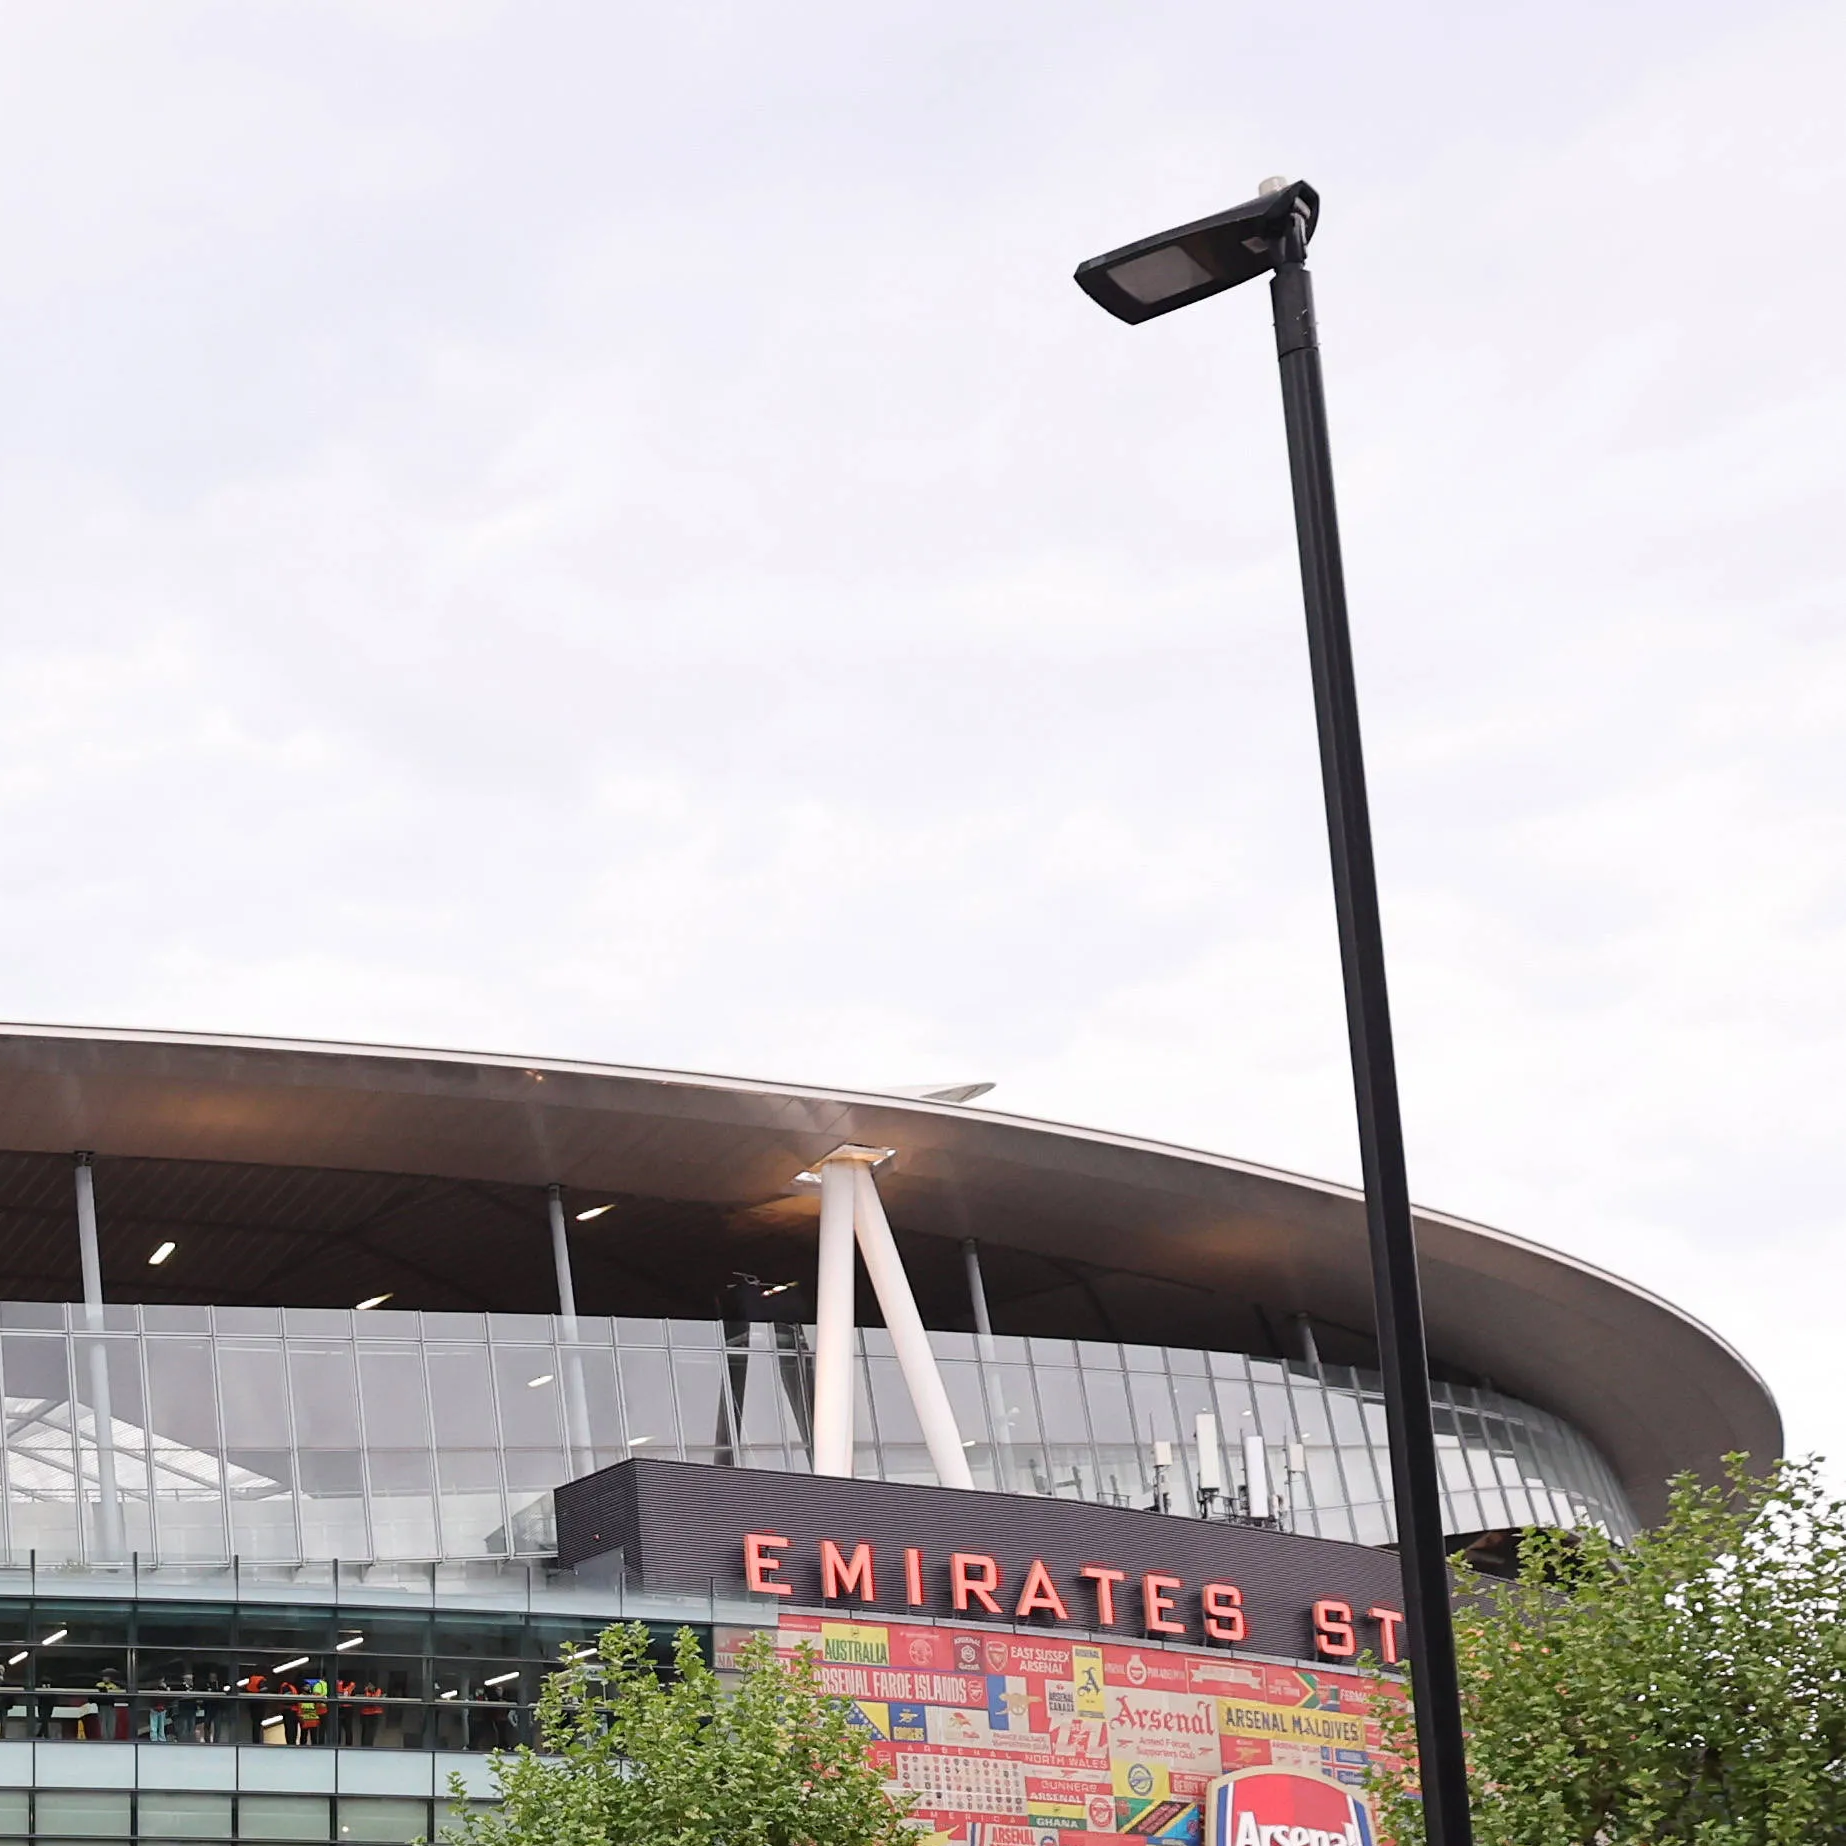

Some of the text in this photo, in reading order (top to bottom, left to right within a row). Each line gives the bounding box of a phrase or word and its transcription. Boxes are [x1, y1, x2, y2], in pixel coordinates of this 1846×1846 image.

[743, 1532, 1248, 1641] EMIRATES
[825, 1638, 888, 1665] AUSTRALIA
[1010, 1646, 1069, 1663] EAST SUSSEX
[1019, 1659, 1064, 1675] ARSENAL
[813, 1666, 967, 1703] ARSENAL FAROE ISLANDS
[1109, 1693, 1216, 1736] Arsenal
[1225, 1706, 1359, 1742] ARSENAL MALDIVES
[1024, 1753, 1108, 1770] NORTH WALES
[1041, 1780, 1098, 1793] GUNNERS
[1030, 1791, 1083, 1804] ARSENAL
[1036, 1816, 1080, 1829] GHANA
[992, 1827, 1036, 1845] ARSENAL
